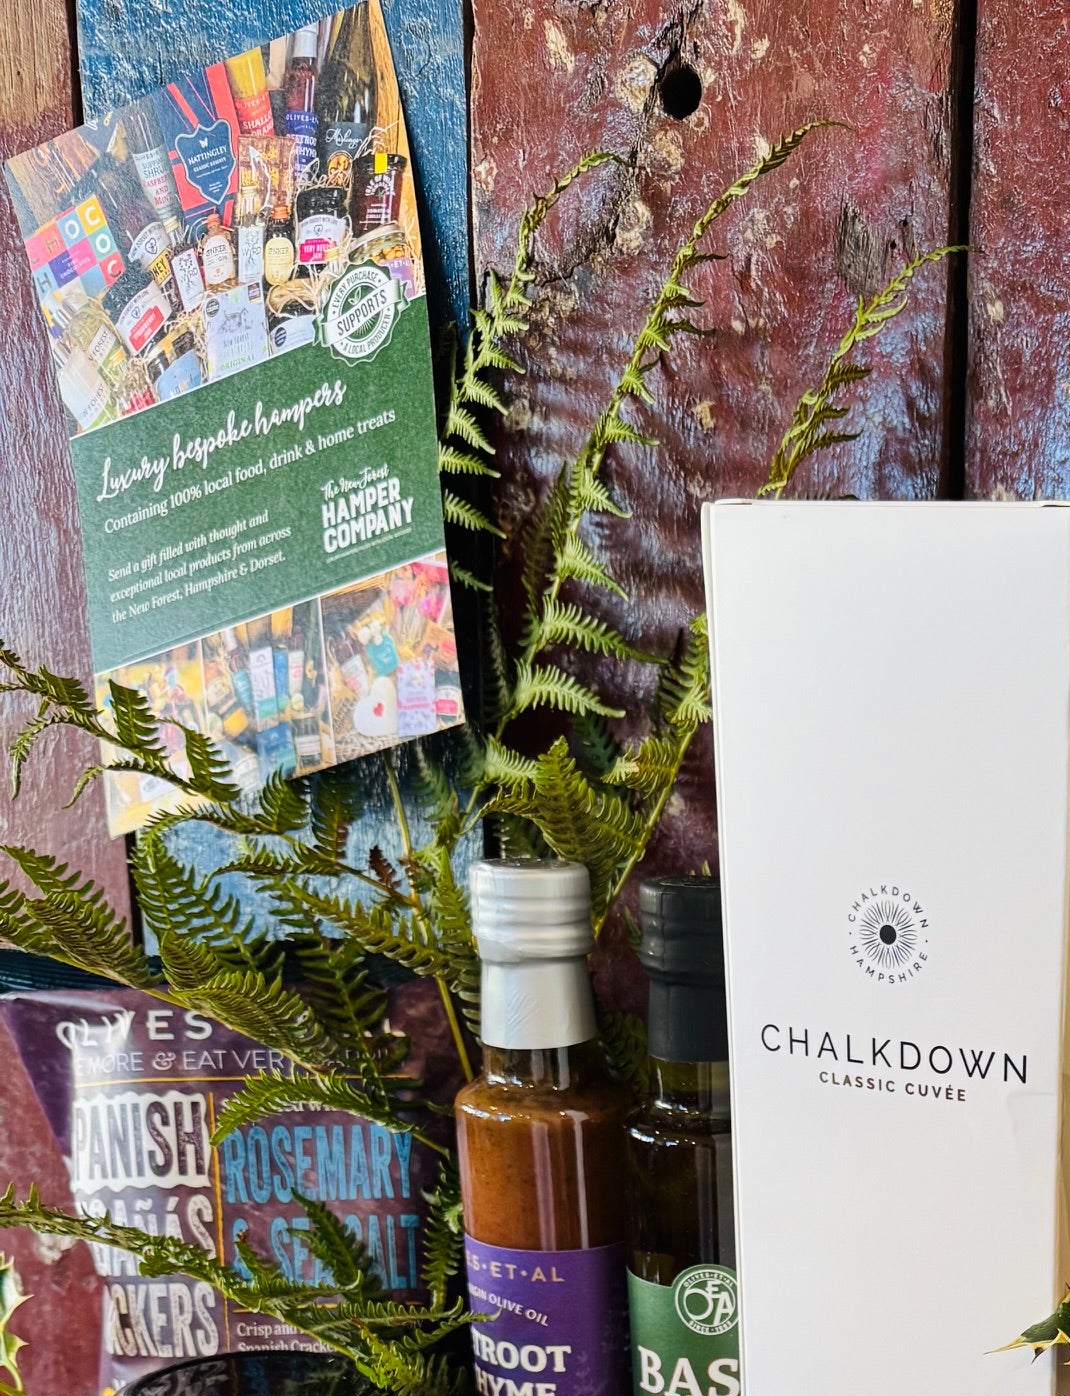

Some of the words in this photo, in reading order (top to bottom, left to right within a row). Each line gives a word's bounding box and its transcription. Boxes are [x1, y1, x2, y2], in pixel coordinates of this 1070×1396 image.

[336, 288, 388, 337] SUPPORTS
[97, 455, 171, 502] Luxury
[172, 409, 252, 470] bespoke
[255, 378, 347, 435] hampers
[104, 499, 169, 534] Containing
[170, 485, 203, 510] 100%
[203, 473, 234, 497] local
[234, 462, 268, 488] food,
[268, 444, 304, 471] drink
[304, 440, 317, 457] &
[317, 424, 355, 451] home
[357, 408, 396, 436] treats
[321, 476, 401, 529] HAMPER
[323, 496, 415, 553] COMPANY
[108, 563, 132, 582] Send
[184, 535, 208, 553] with
[208, 519, 247, 546] thought
[248, 509, 270, 528] and
[109, 571, 163, 603] exceptional
[163, 564, 188, 584] local
[188, 547, 231, 577] products
[258, 526, 292, 545] across
[111, 607, 128, 624] the
[128, 602, 151, 617] New
[151, 587, 184, 611] Forest,
[184, 567, 239, 600] Hampshire
[249, 551, 287, 574] Dorset.
[847, 884, 929, 929] CHALKDOWN
[849, 945, 928, 984] HAMPSHIRE
[151, 1051, 176, 1071] &
[182, 1050, 227, 1071] EAT
[760, 1023, 1028, 1085] CHALKDOWN
[818, 1070, 896, 1094] CLASSIC
[904, 1082, 967, 1103] CUVÉE
[222, 1122, 413, 1206] ROSEMARY
[236, 1322, 273, 1338] Crisp
[274, 1322, 297, 1335] and
[489, 1293, 523, 1317] OLIVE
[524, 1307, 549, 1328] OIL
